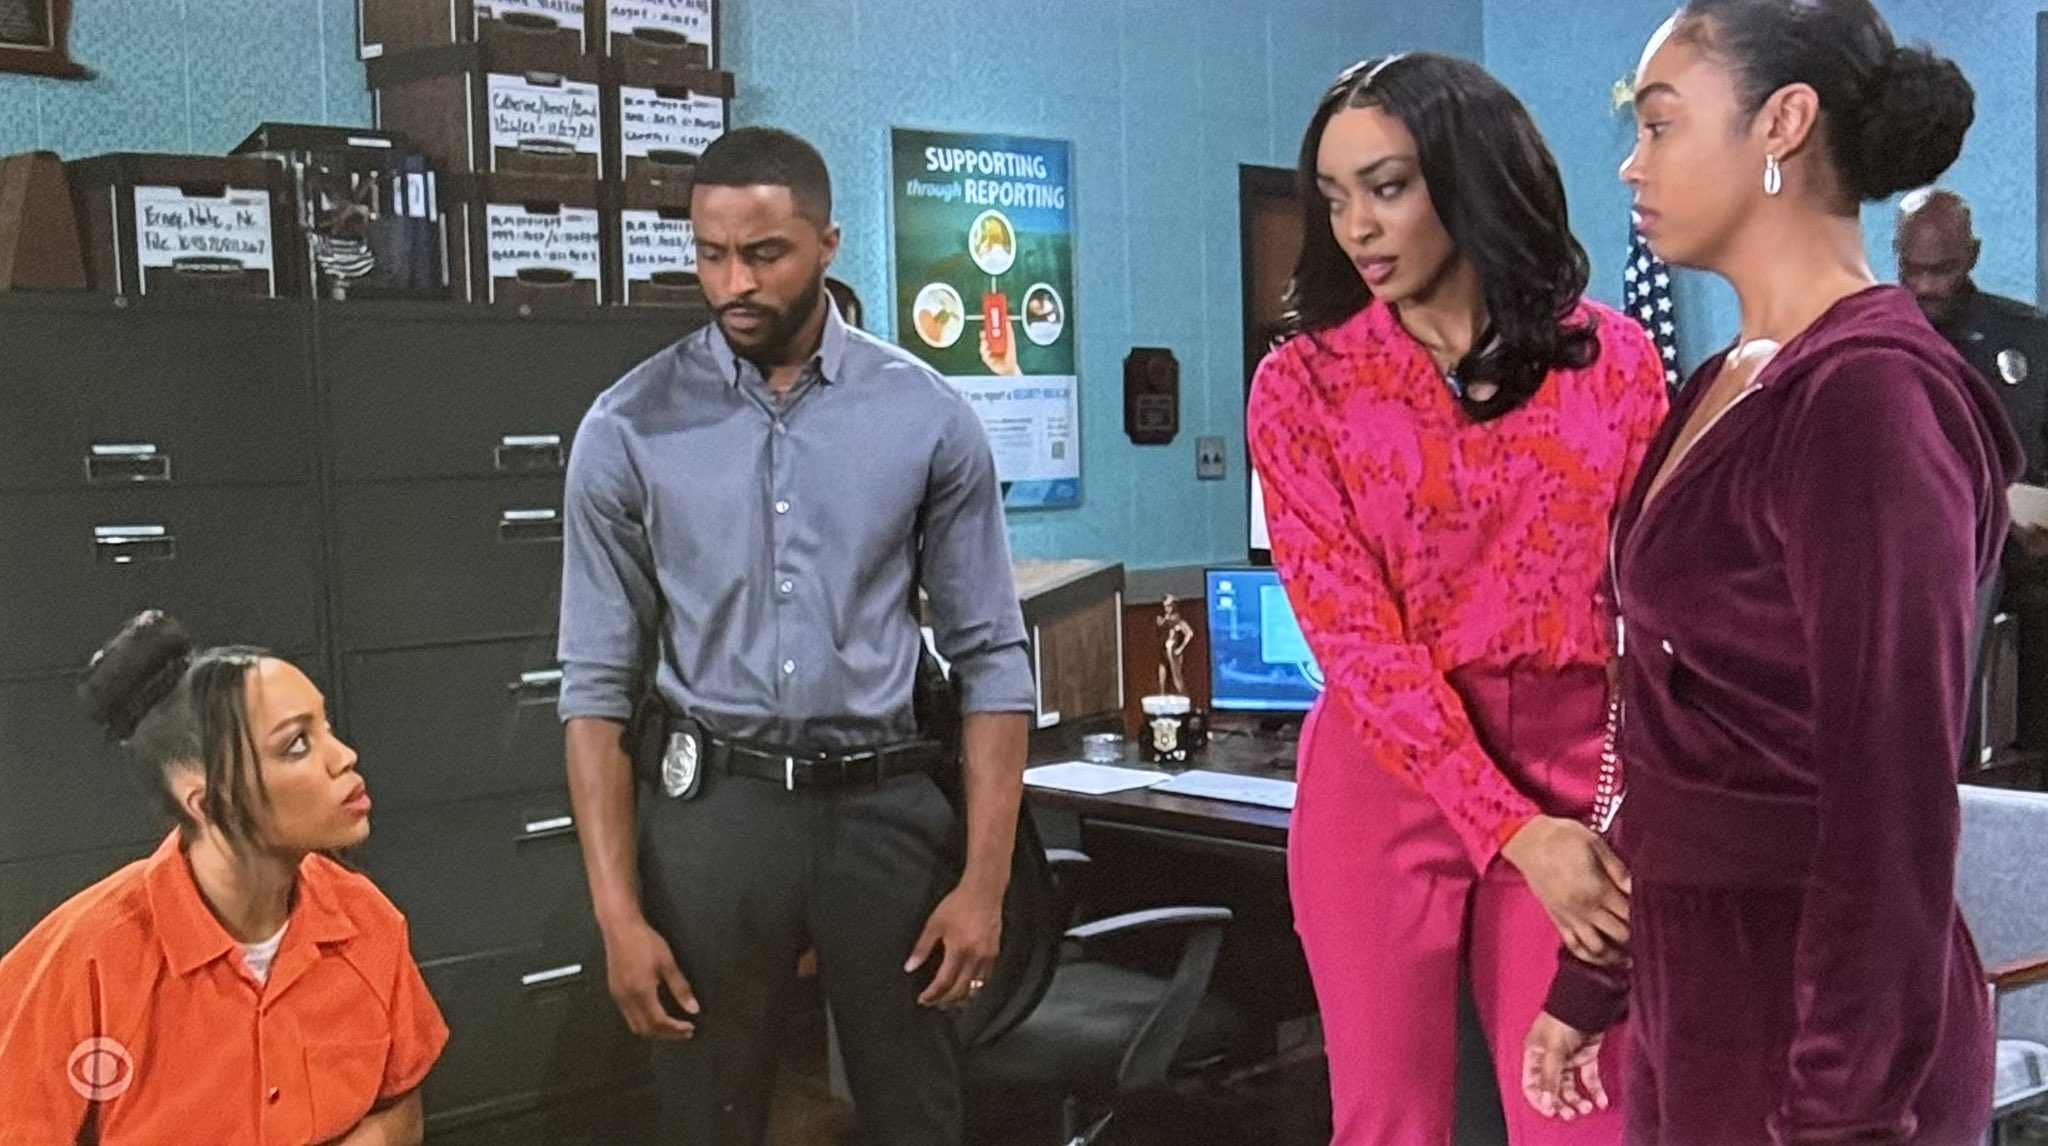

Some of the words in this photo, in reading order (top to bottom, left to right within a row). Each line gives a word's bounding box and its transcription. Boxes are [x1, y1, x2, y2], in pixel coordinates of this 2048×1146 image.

[925, 147, 1047, 179] SUPPORTING
[906, 179, 962, 202] through
[964, 178, 1065, 209] REPORTING
